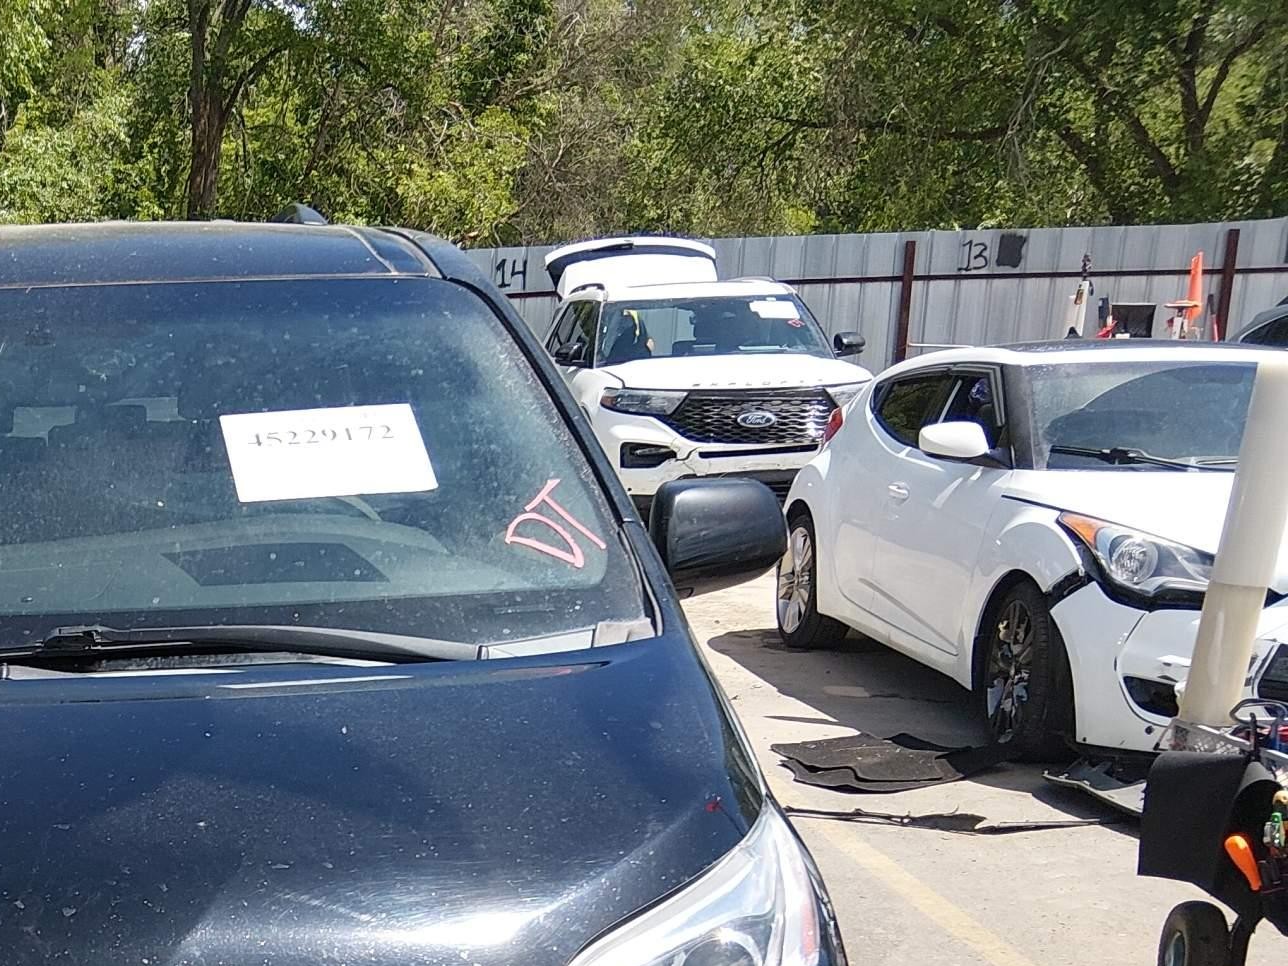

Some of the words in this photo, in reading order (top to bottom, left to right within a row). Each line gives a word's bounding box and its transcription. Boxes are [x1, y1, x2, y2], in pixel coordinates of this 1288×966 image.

[957, 239, 989, 272] 13
[495, 258, 528, 291] 14
[247, 424, 395, 447] 45229172
[743, 413, 772, 425] Ford
[504, 479, 607, 568] DT
